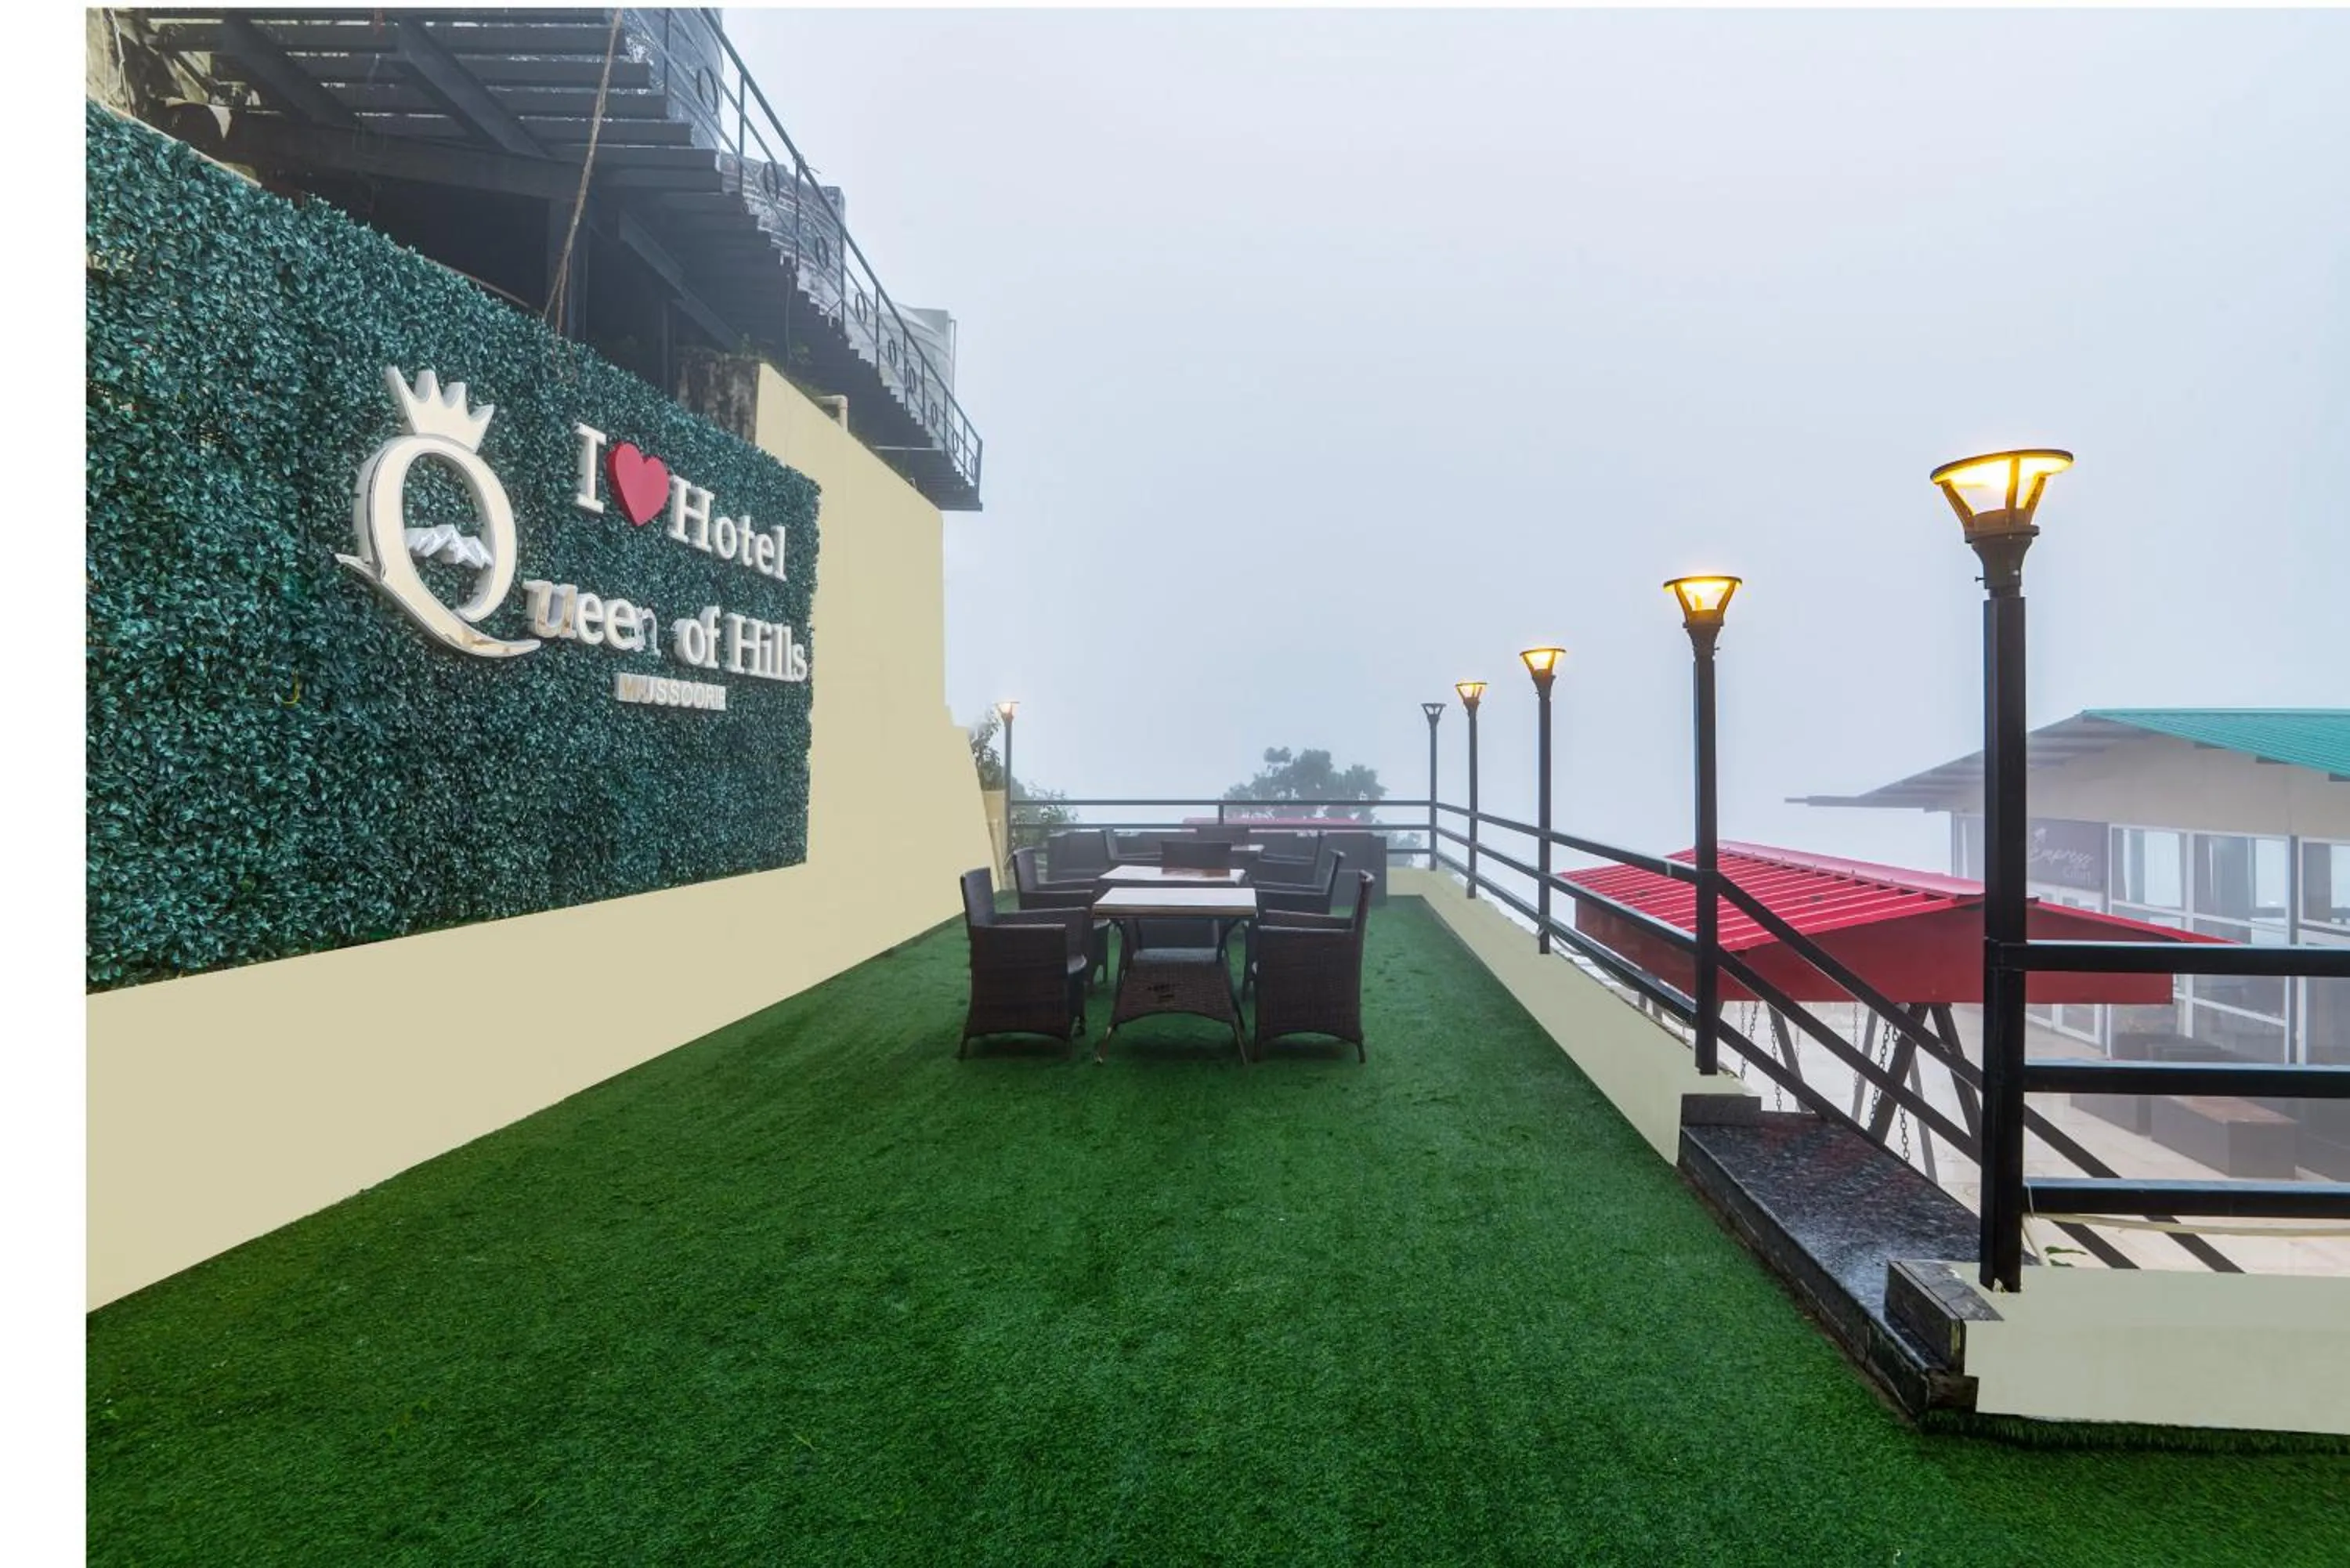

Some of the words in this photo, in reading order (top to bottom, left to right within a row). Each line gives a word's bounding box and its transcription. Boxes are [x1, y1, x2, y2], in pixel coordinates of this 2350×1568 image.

[335, 434, 661, 658] Queen
[672, 606, 720, 668] of
[723, 612, 808, 681] Hills
[573, 421, 607, 514] I
[667, 474, 786, 581] Hotel
